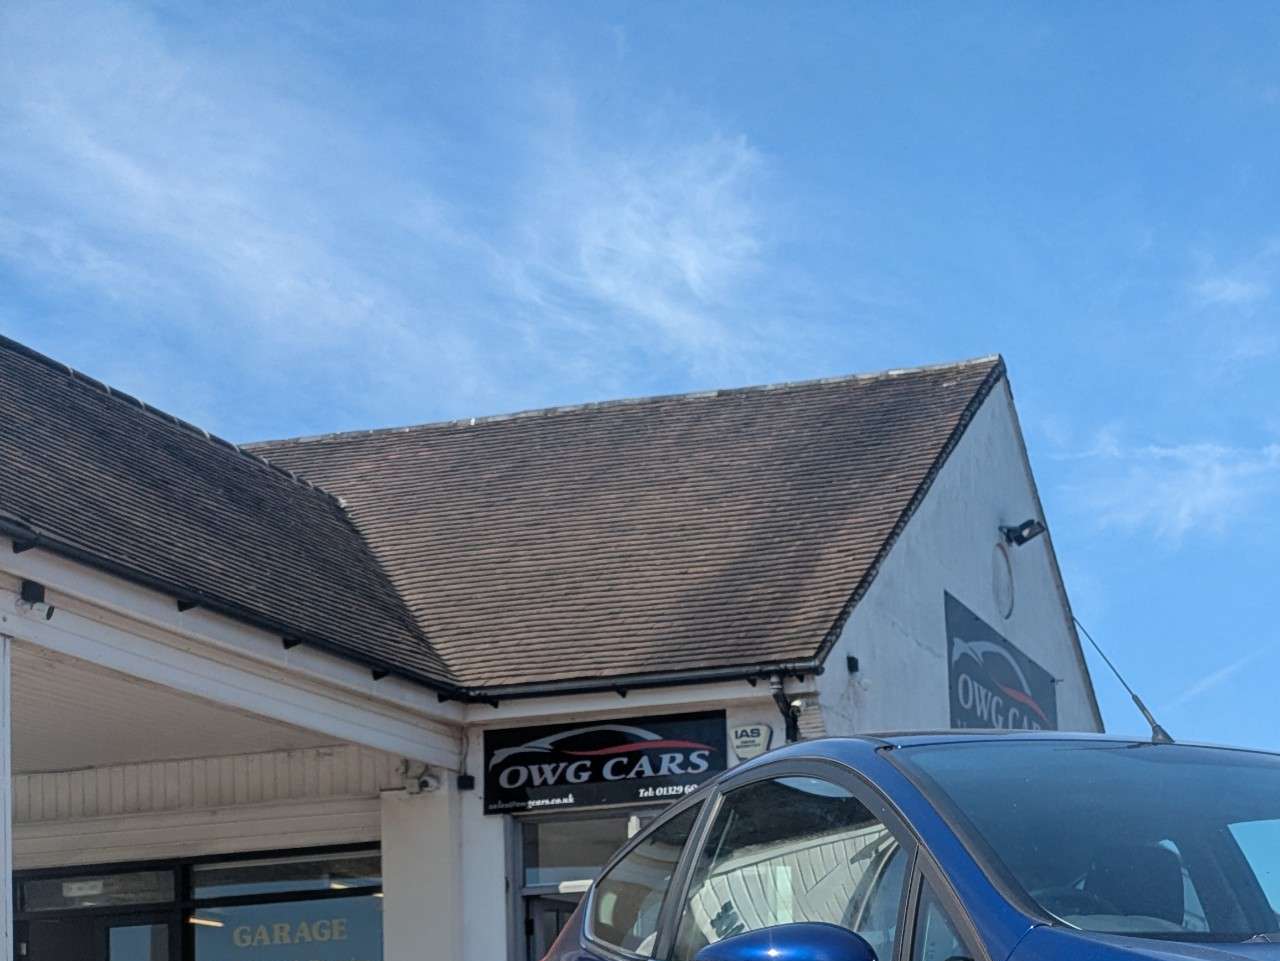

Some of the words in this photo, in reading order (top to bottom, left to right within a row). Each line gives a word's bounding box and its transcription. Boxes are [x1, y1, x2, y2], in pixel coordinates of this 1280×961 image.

[957, 673, 1004, 729] OWG
[734, 728, 761, 739] IAS
[500, 760, 592, 788] OWG
[602, 749, 710, 780] CARS
[233, 918, 348, 947] GARAGE
